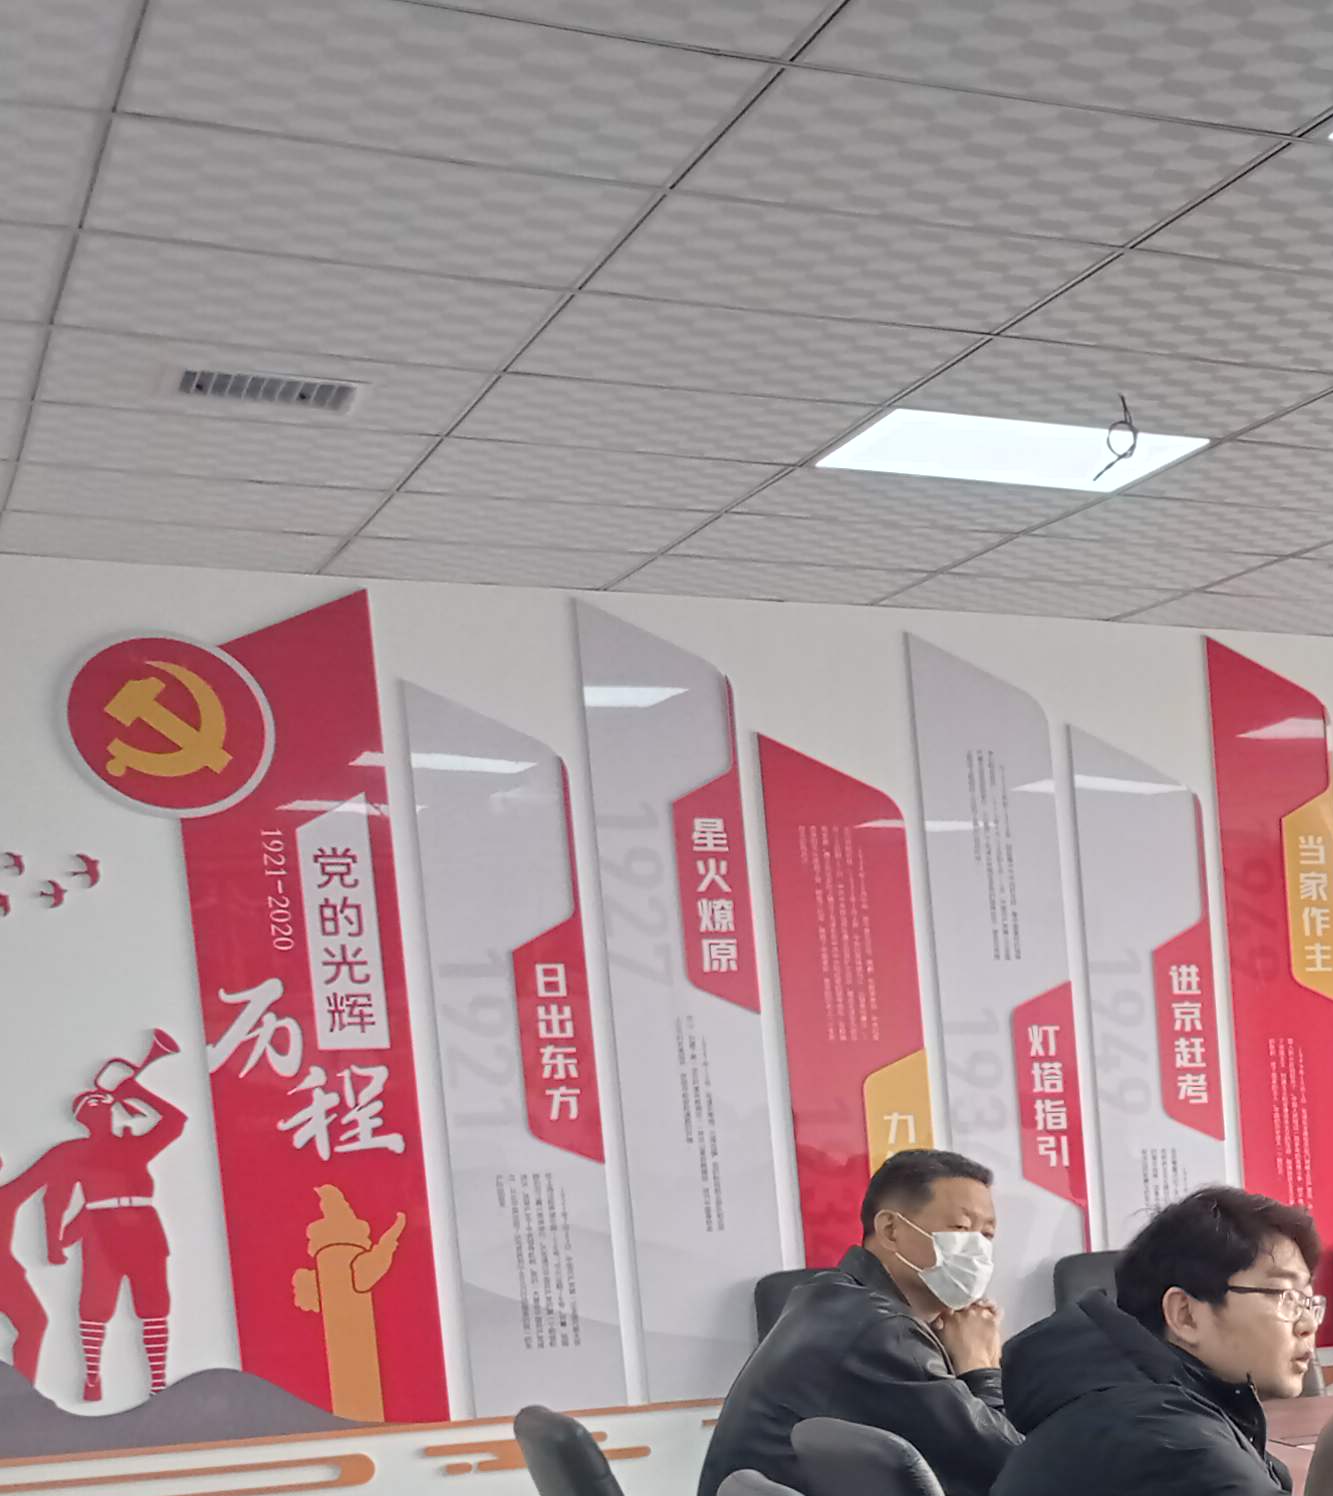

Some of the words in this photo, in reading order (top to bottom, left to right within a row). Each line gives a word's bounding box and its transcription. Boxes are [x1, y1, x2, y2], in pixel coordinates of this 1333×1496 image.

[261, 828, 294, 952] 1921-2020
[312, 847, 376, 1034] 党的光辉
[691, 816, 738, 973] 星火燎原
[1298, 835, 1333, 974] 当家作主
[206, 978, 405, 1160] 历程
[535, 963, 580, 1121] 日出东方
[1028, 1024, 1070, 1168] 灯塔指引
[1168, 963, 1209, 1105] 进京赶考
[884, 1111, 916, 1158] 力
